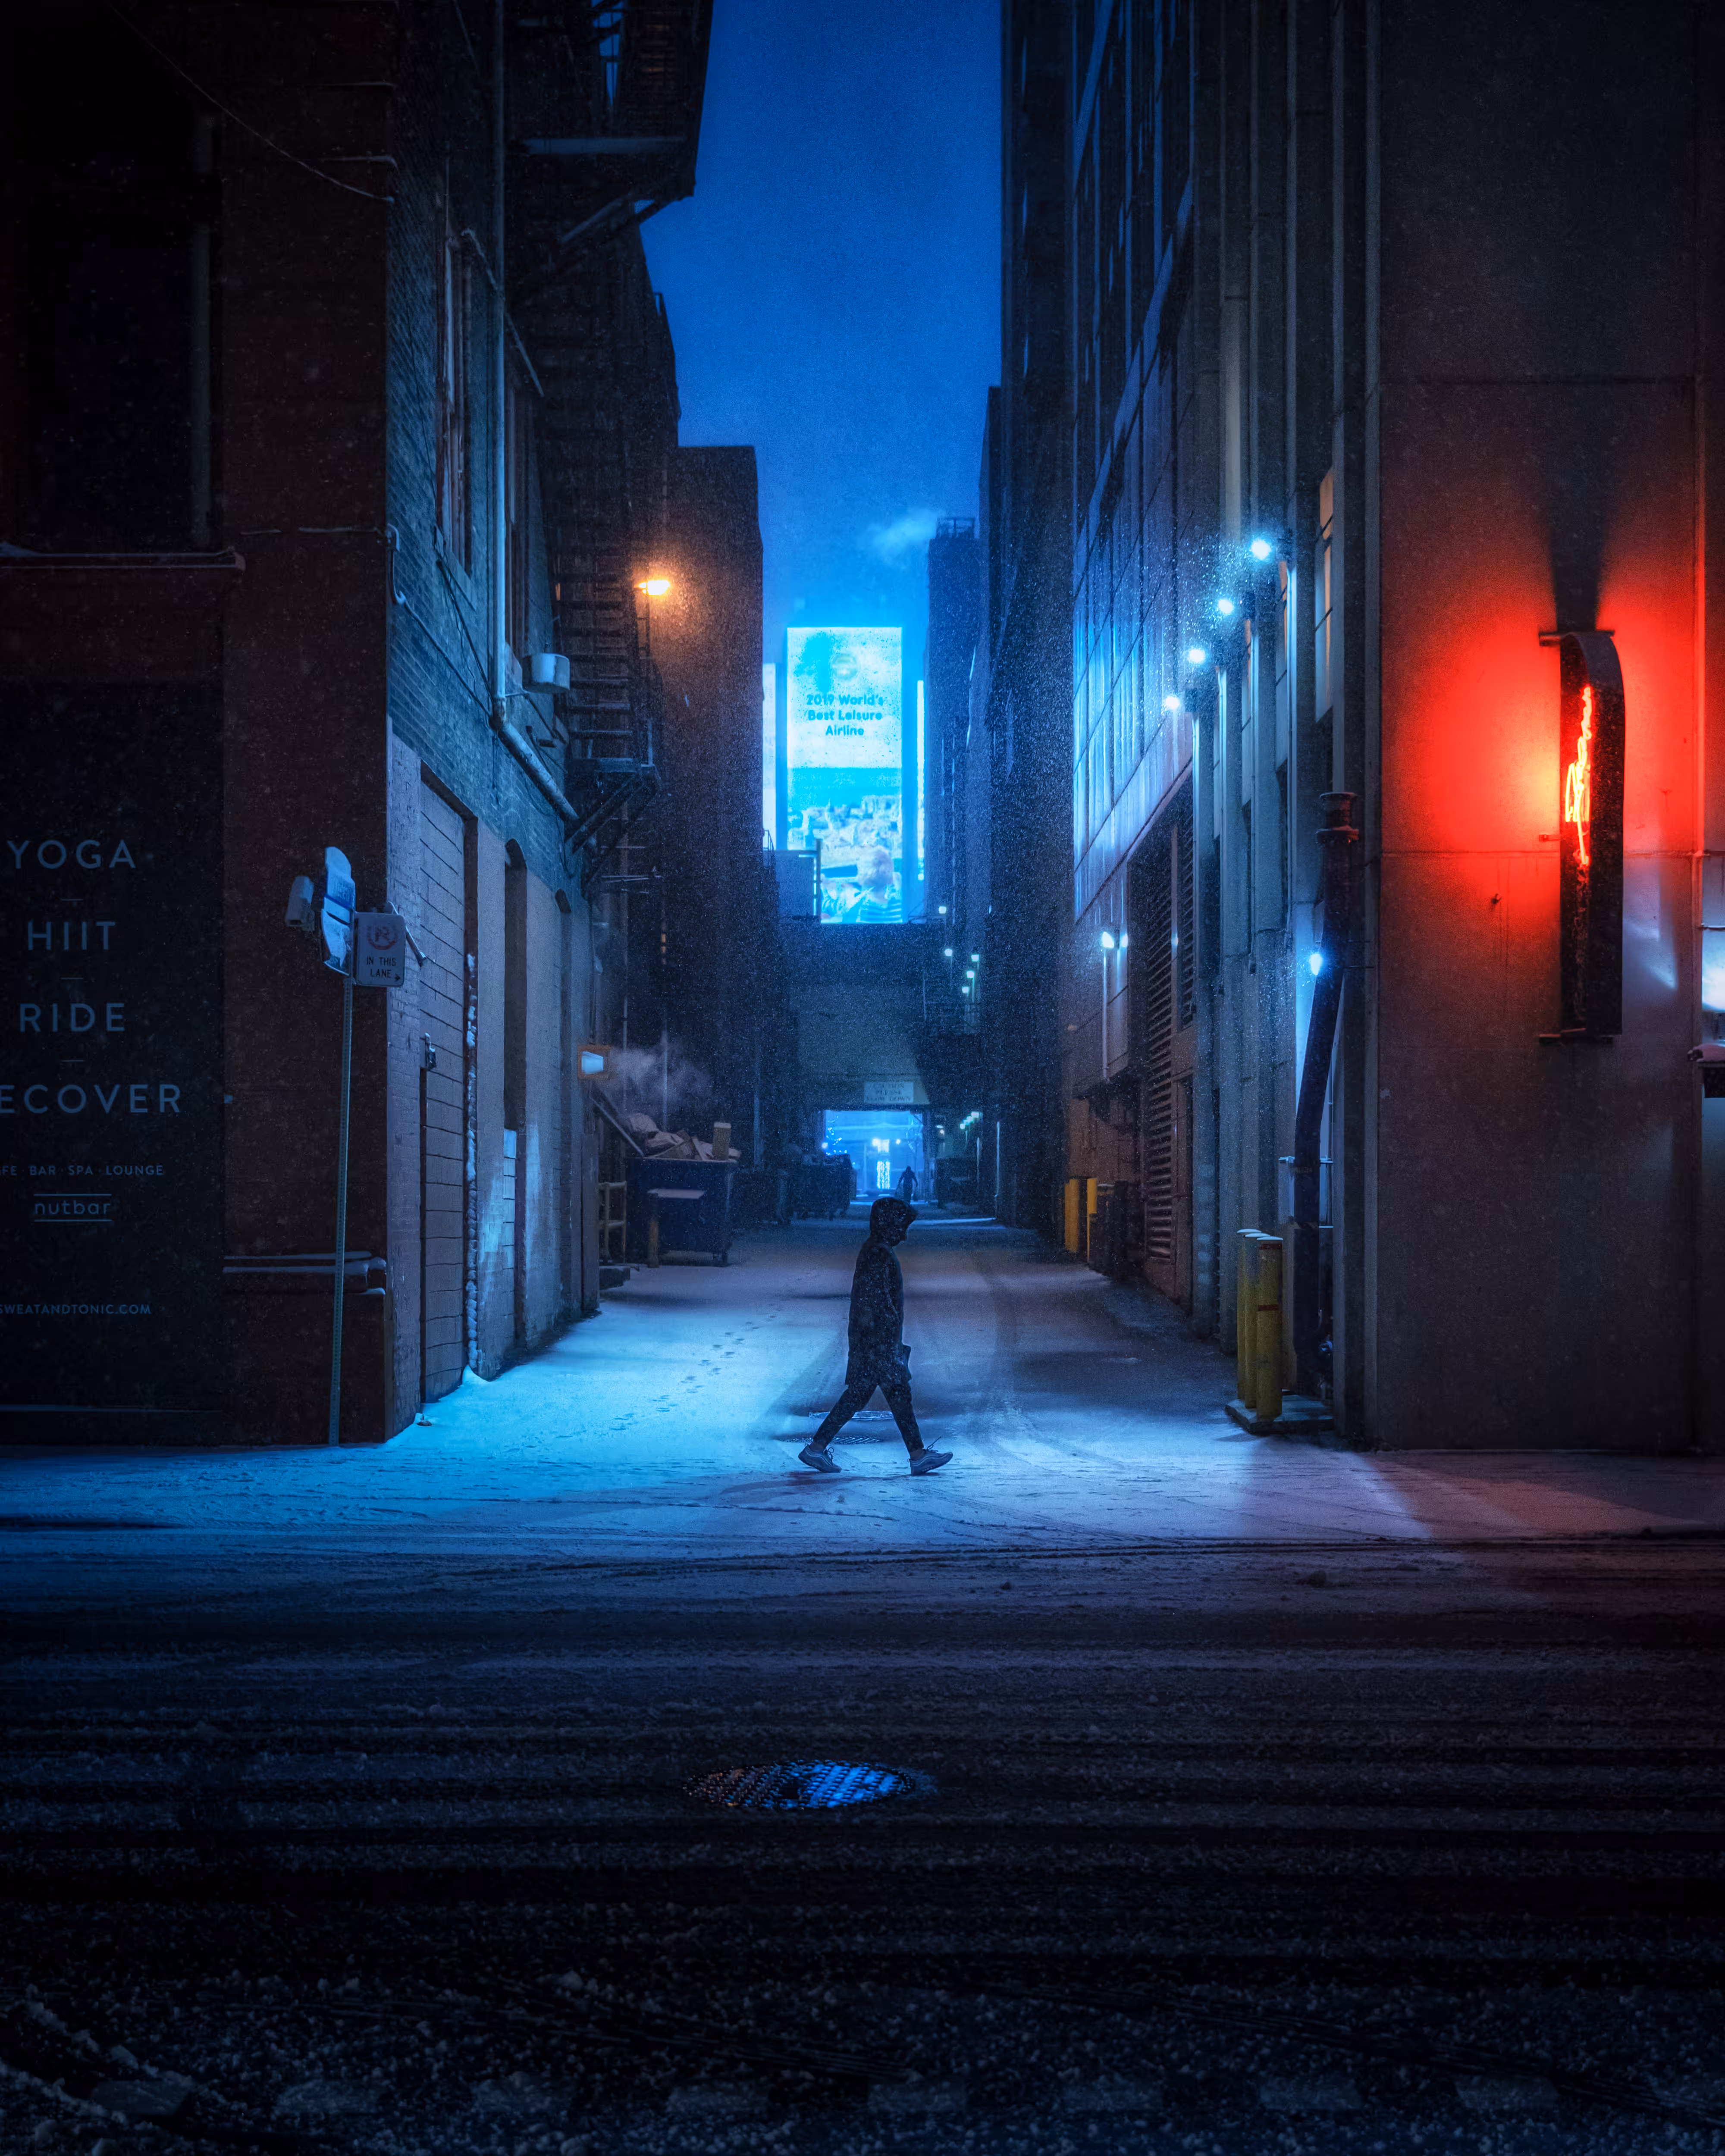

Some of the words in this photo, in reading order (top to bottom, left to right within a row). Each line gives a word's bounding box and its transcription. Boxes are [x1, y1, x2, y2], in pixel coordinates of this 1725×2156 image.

[806, 694, 834, 705] 2019
[838, 693, 884, 706] World's
[808, 709, 835, 721] Best
[838, 709, 882, 721] Leisure
[825, 724, 865, 736] Airline
[6, 839, 136, 869] YOGA
[28, 921, 116, 950] HIIT
[366, 956, 374, 965] IN
[379, 957, 396, 966] THIS
[370, 969, 392, 978] LANE
[20, 1003, 125, 1033] RIDE
[0, 1165, 18, 1176] FE
[30, 1166, 56, 1176] BAR
[68, 1165, 94, 1176] SPA
[106, 1165, 164, 1176] LOUNGE
[34, 1200, 111, 1215] nutbar
